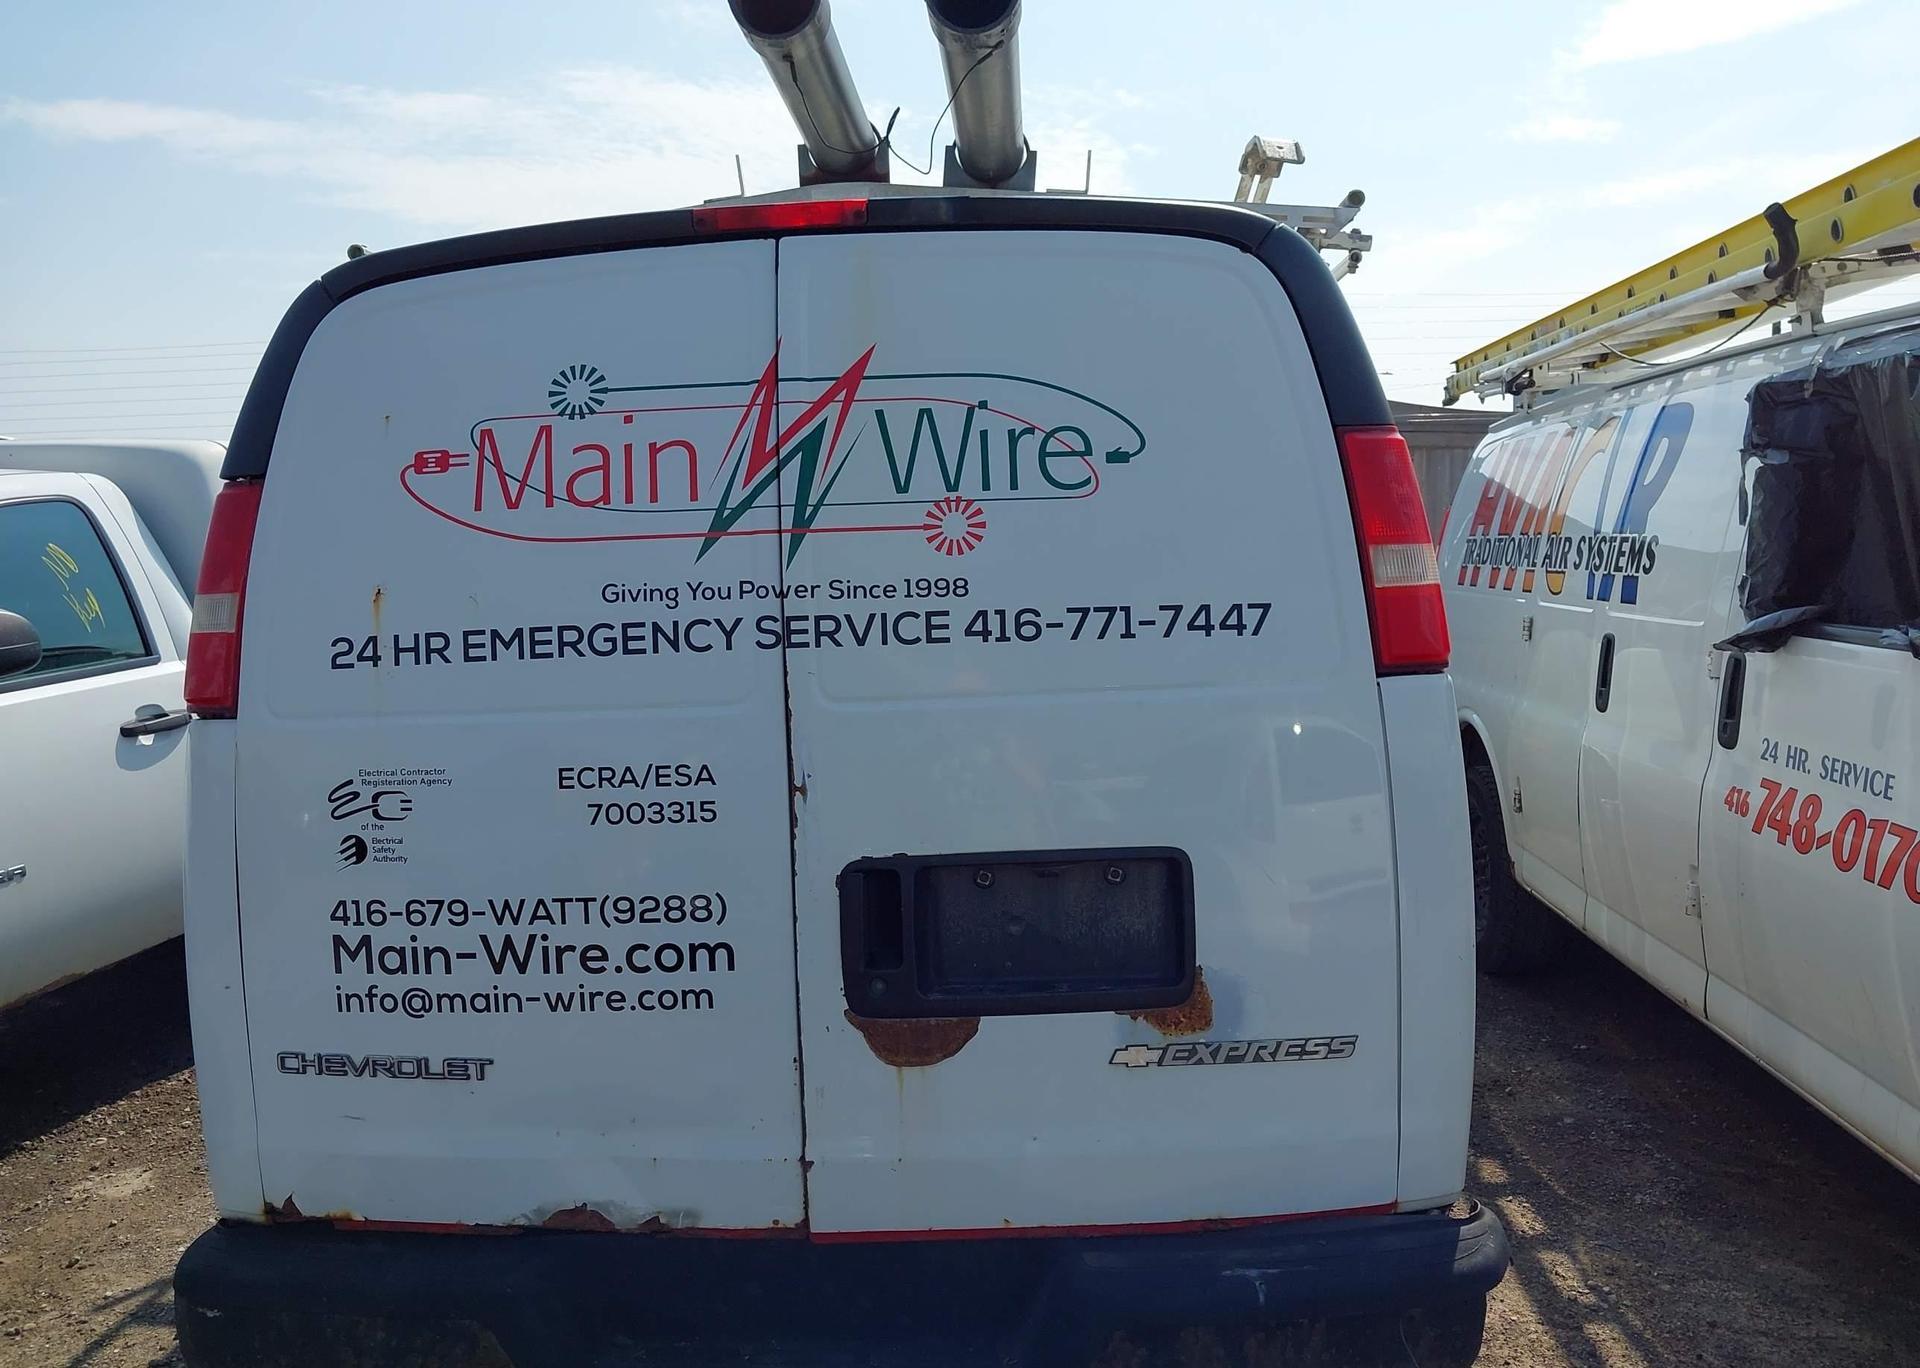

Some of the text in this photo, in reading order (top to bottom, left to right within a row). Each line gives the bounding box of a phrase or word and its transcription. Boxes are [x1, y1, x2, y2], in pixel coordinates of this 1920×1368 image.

[473, 400, 1093, 512] Main Wire
[1462, 534, 1660, 576] TRADITIONAL AIR SYSTEMS
[601, 577, 970, 609] Giving You Power Since 1998
[330, 602, 1272, 669] 24 HR EMERGENCY SERVICE 416-771-7447
[358, 768, 446, 778] Electrical Contractor
[361, 777, 453, 788] Registeration Agency
[557, 763, 718, 791] ECRA/ESA
[1759, 737, 1895, 801] 24 HR. SERVICE
[587, 800, 718, 826] 7003315
[1723, 785, 1752, 818] 416
[360, 823, 385, 831] of the
[371, 837, 404, 845] Electrical
[372, 846, 396, 856] Safety
[372, 855, 409, 865] Authority
[329, 891, 728, 929] 416-679-WATT(9288)
[332, 933, 736, 976] Main-Wire.com
[335, 983, 715, 1019] info@main-wire.com
[276, 1051, 494, 1081] CHEVROLET
[1158, 1035, 1359, 1067] EXPRESS
